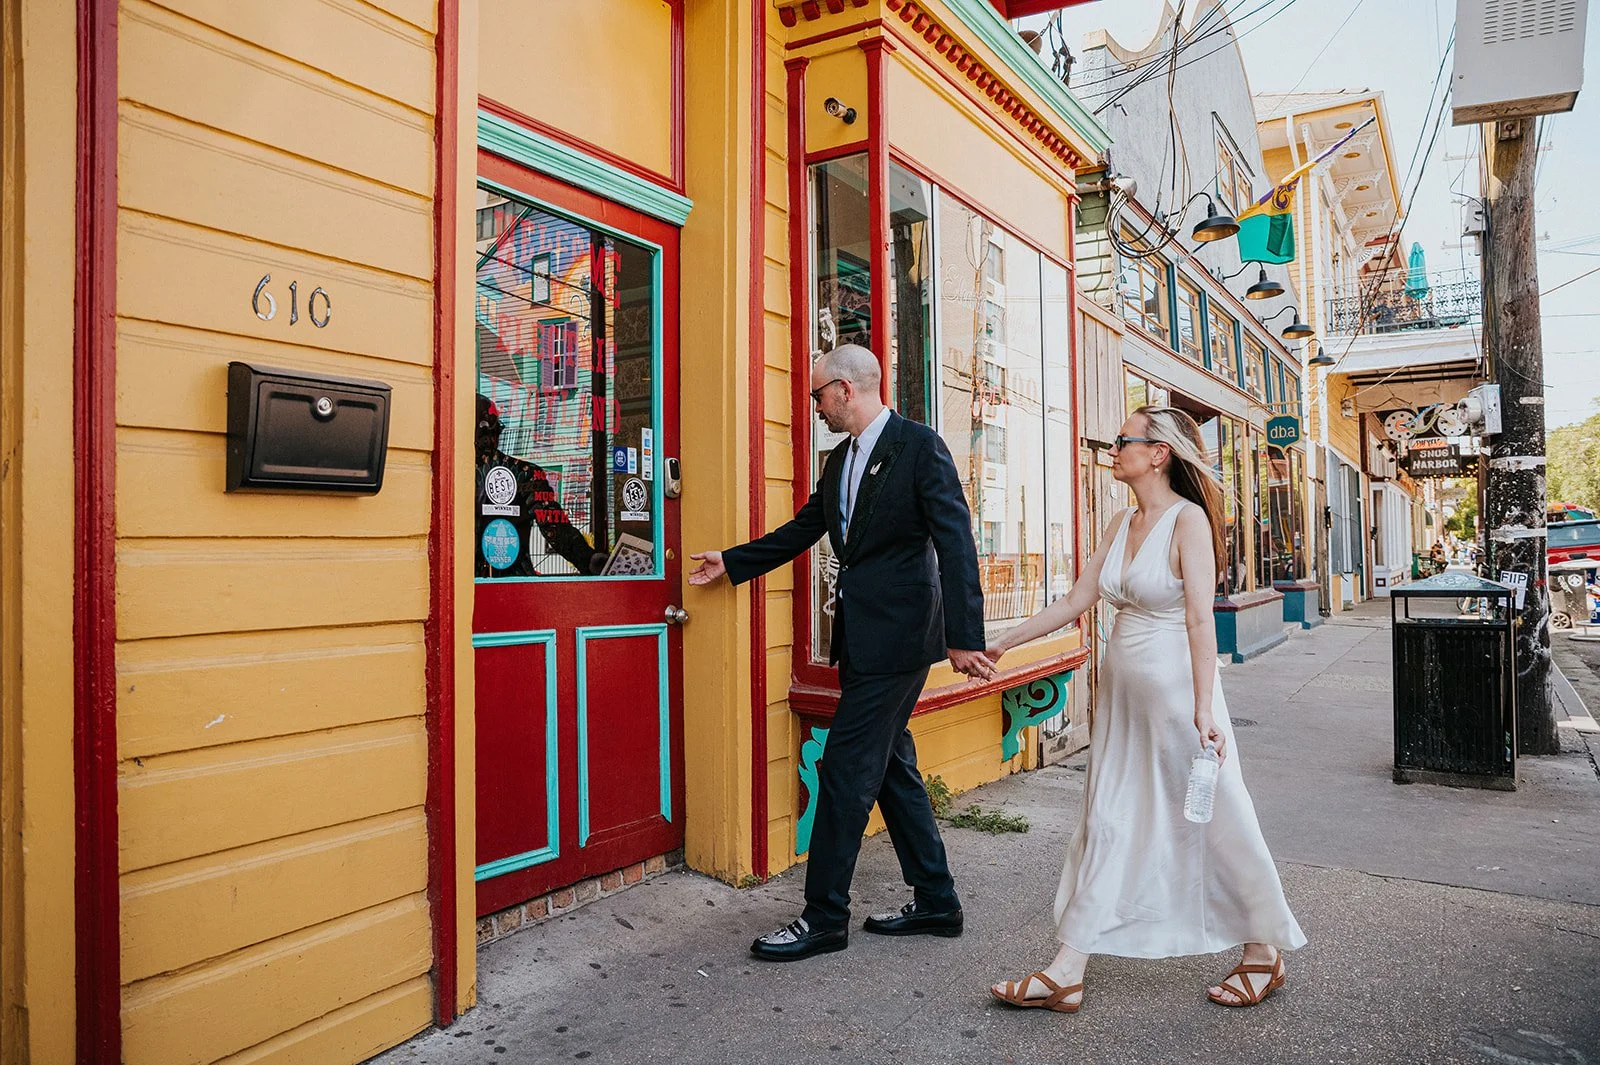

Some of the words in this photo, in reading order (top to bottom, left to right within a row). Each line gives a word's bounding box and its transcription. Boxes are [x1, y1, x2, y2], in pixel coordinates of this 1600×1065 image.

[493, 209, 622, 309] WELCOME
[252, 273, 331, 328] 610
[495, 312, 618, 376] ELECTRIC
[488, 375, 621, 435] LADYLAND
[1420, 449, 1449, 458] SNUG
[1412, 459, 1458, 470] HARBOR
[489, 480, 511, 494] BEST
[534, 491, 558, 502] MUST
[533, 509, 569, 523] WITH
